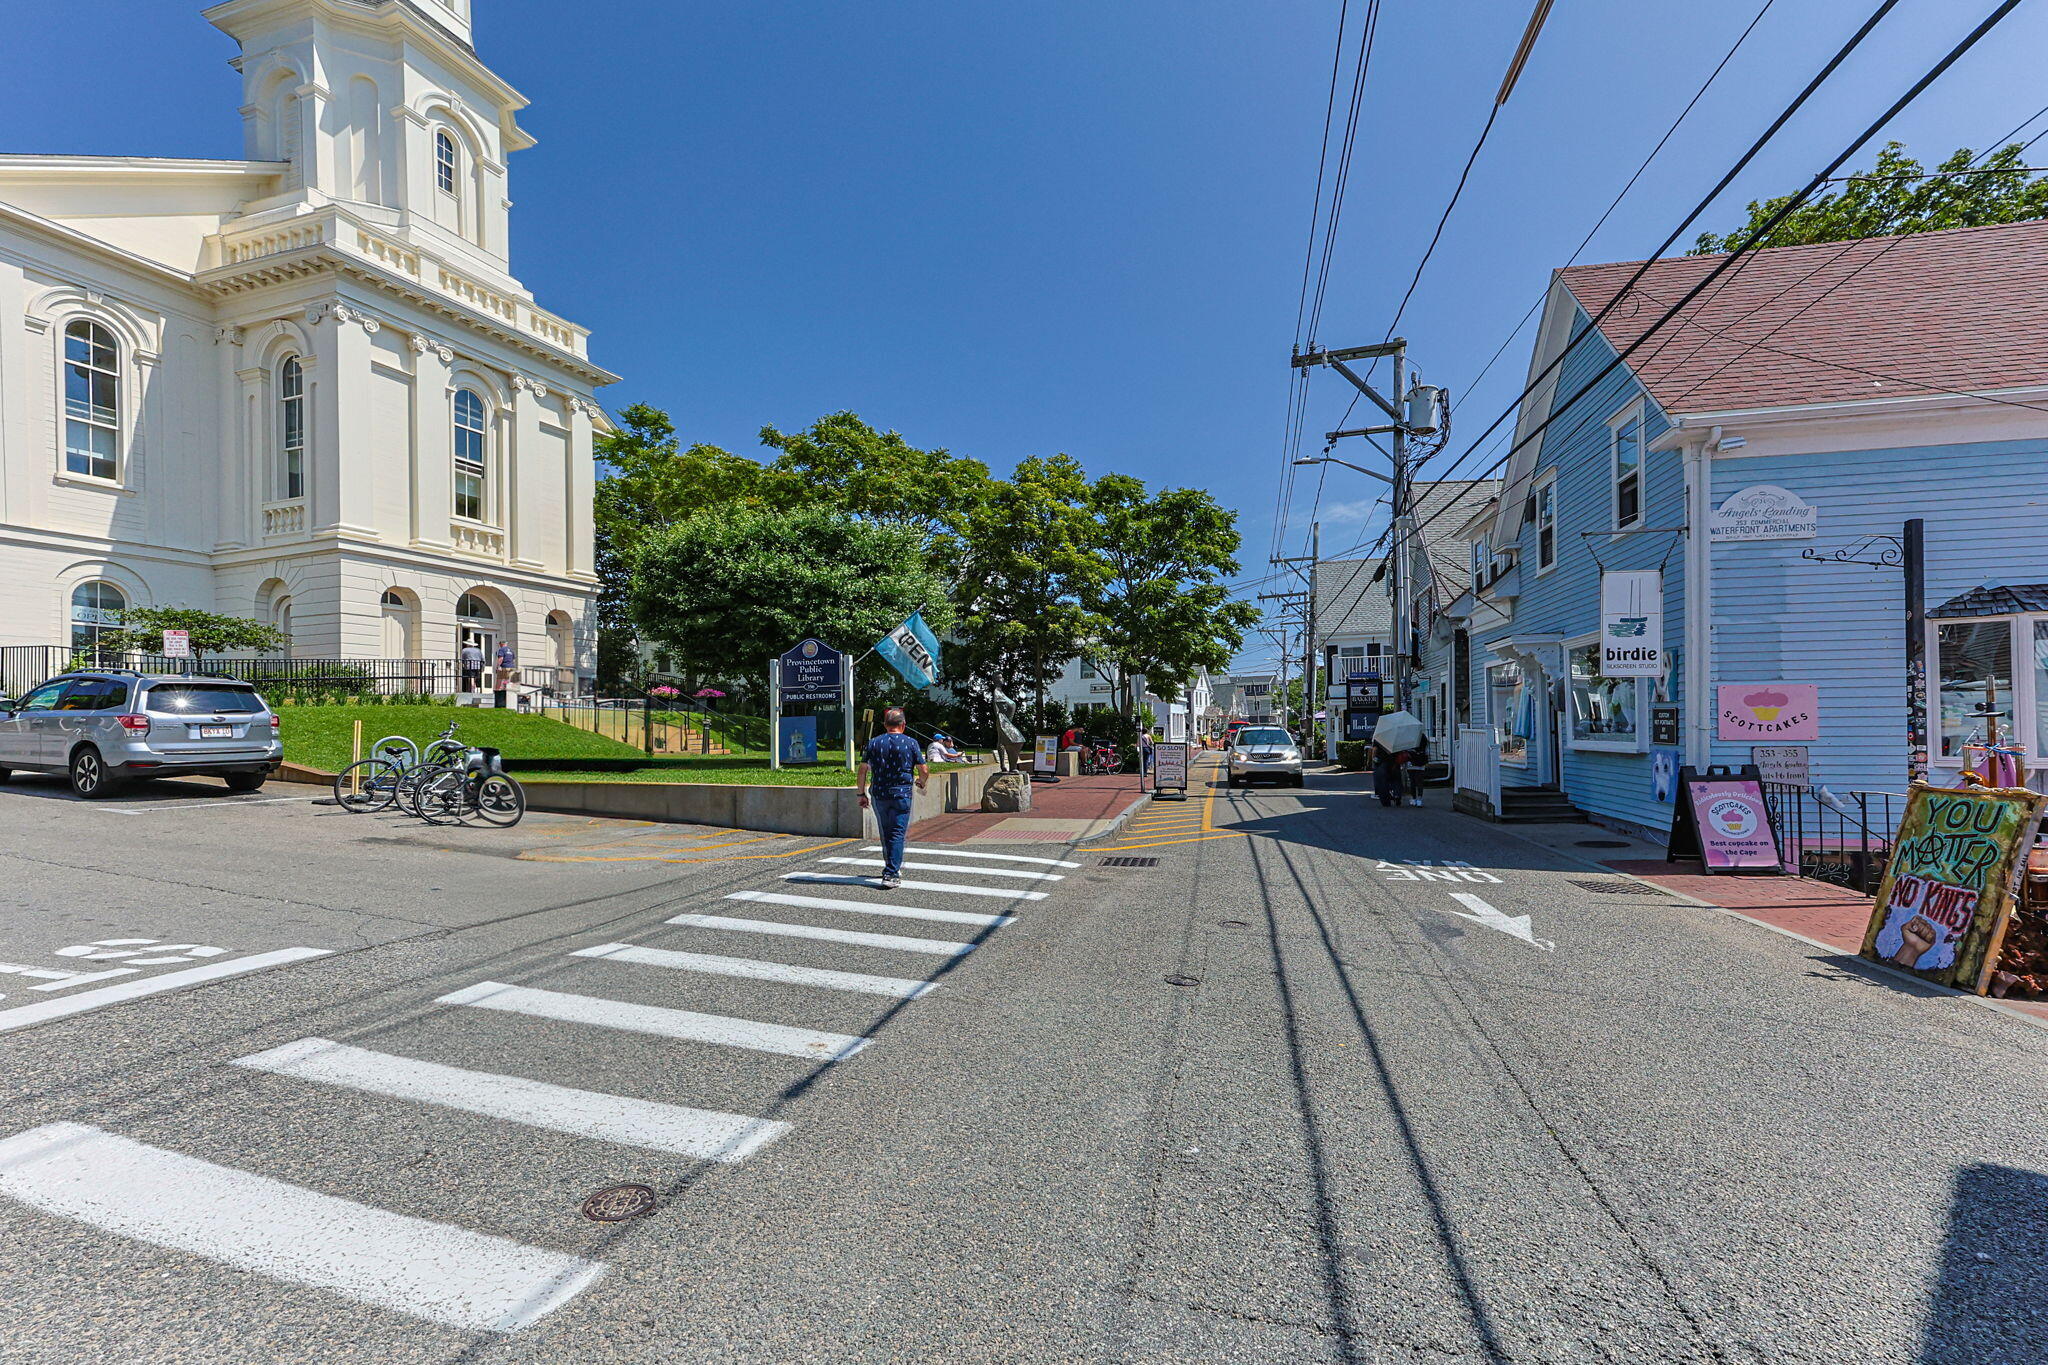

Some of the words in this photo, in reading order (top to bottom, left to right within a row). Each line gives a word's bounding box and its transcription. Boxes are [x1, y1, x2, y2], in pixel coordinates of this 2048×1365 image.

[1762, 506, 1810, 519] Landing
[1709, 525, 1760, 535] WATERFRONT
[1763, 523, 1817, 533] APARTMENTS
[1606, 647, 1658, 661] birdie
[786, 658, 835, 666] Provincetown
[799, 665, 823, 673] Public
[797, 673, 825, 682] Library
[1723, 710, 1809, 732] SCOTTCAKES
[1927, 798, 2008, 835] YOU
[1728, 840, 1758, 848] cupcake
[1739, 849, 1758, 857] Cape
[1892, 827, 1999, 889] MATTER
[1375, 868, 1505, 884] ONE
[1889, 875, 1920, 910] NO
[1918, 880, 1977, 934] KINGS
